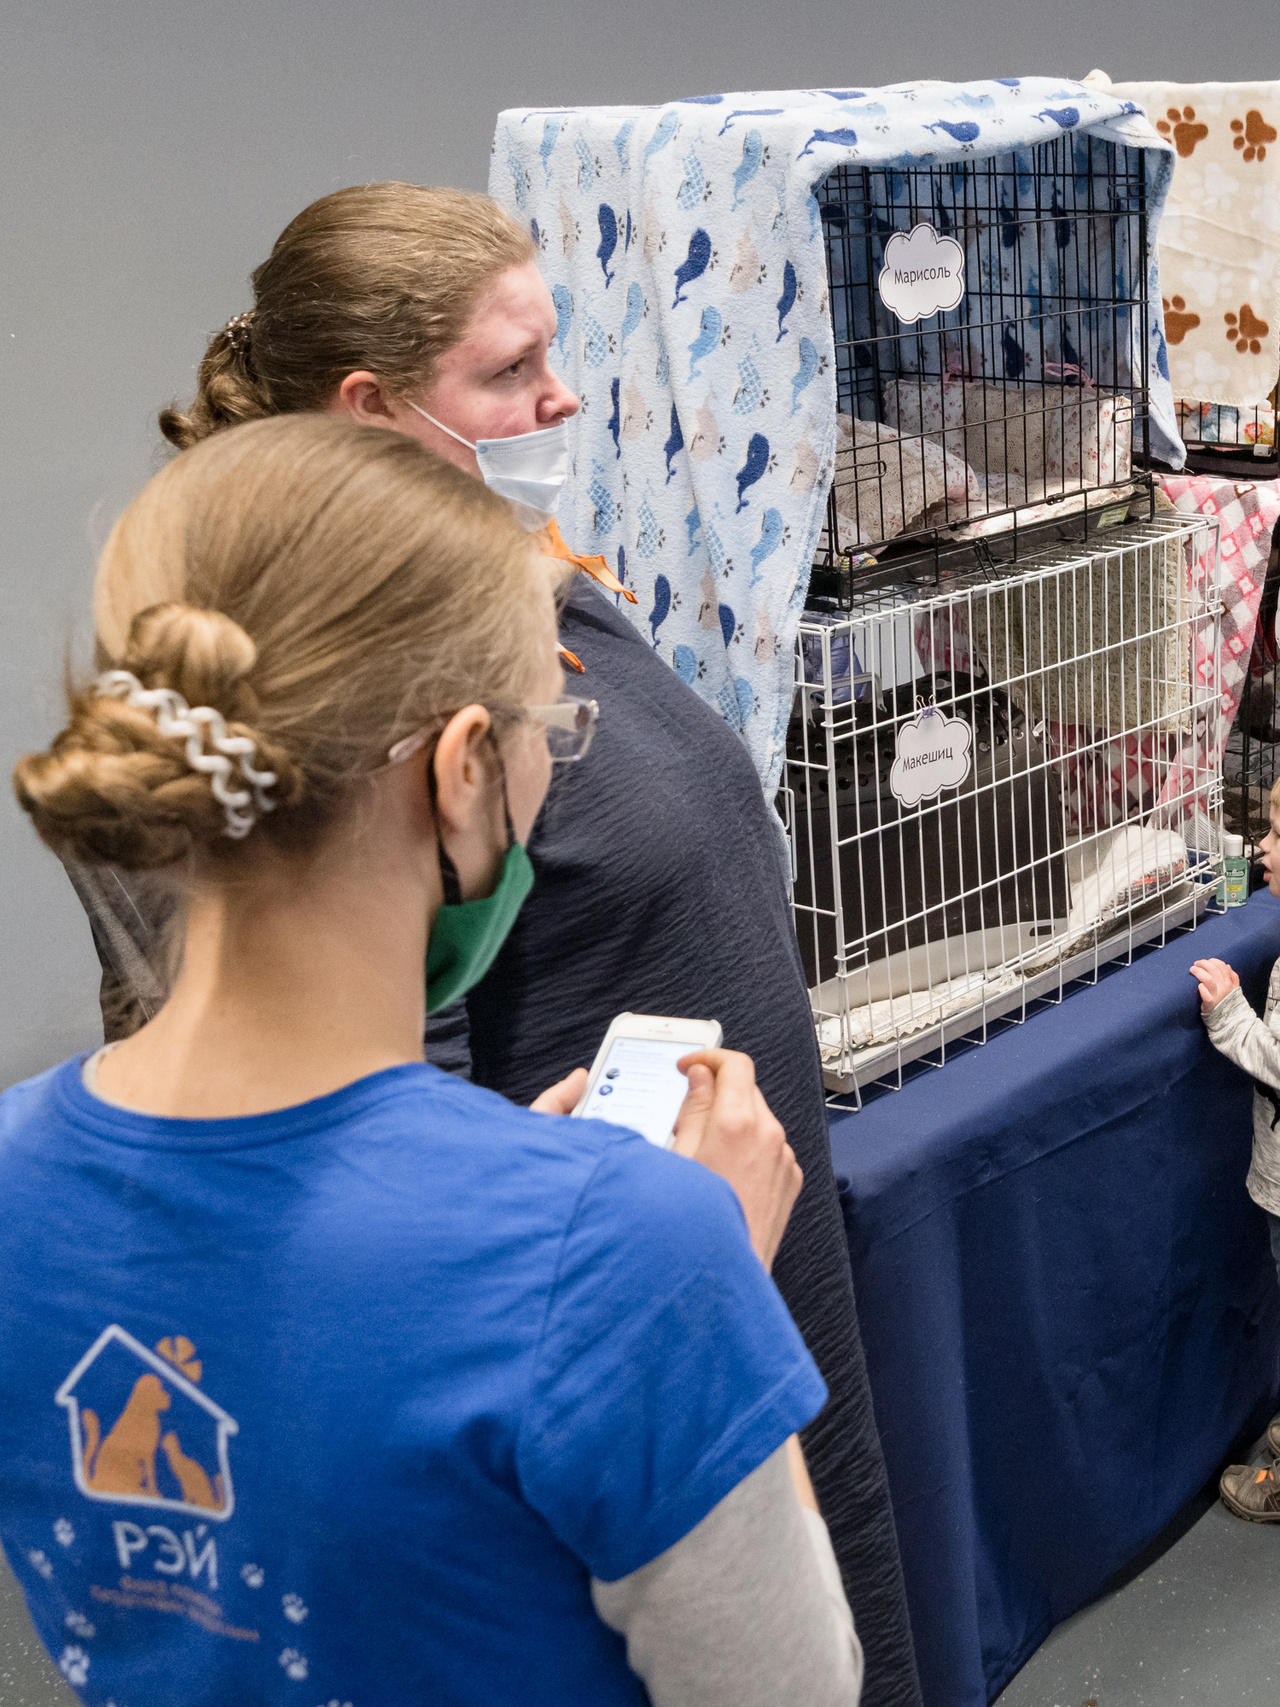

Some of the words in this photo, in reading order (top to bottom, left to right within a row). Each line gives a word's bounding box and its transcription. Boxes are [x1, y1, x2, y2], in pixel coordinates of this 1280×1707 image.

[894, 266, 951, 287] Марисоль
[902, 747, 954, 773] Макешиц
[111, 1520, 219, 1591] РЭЙ
